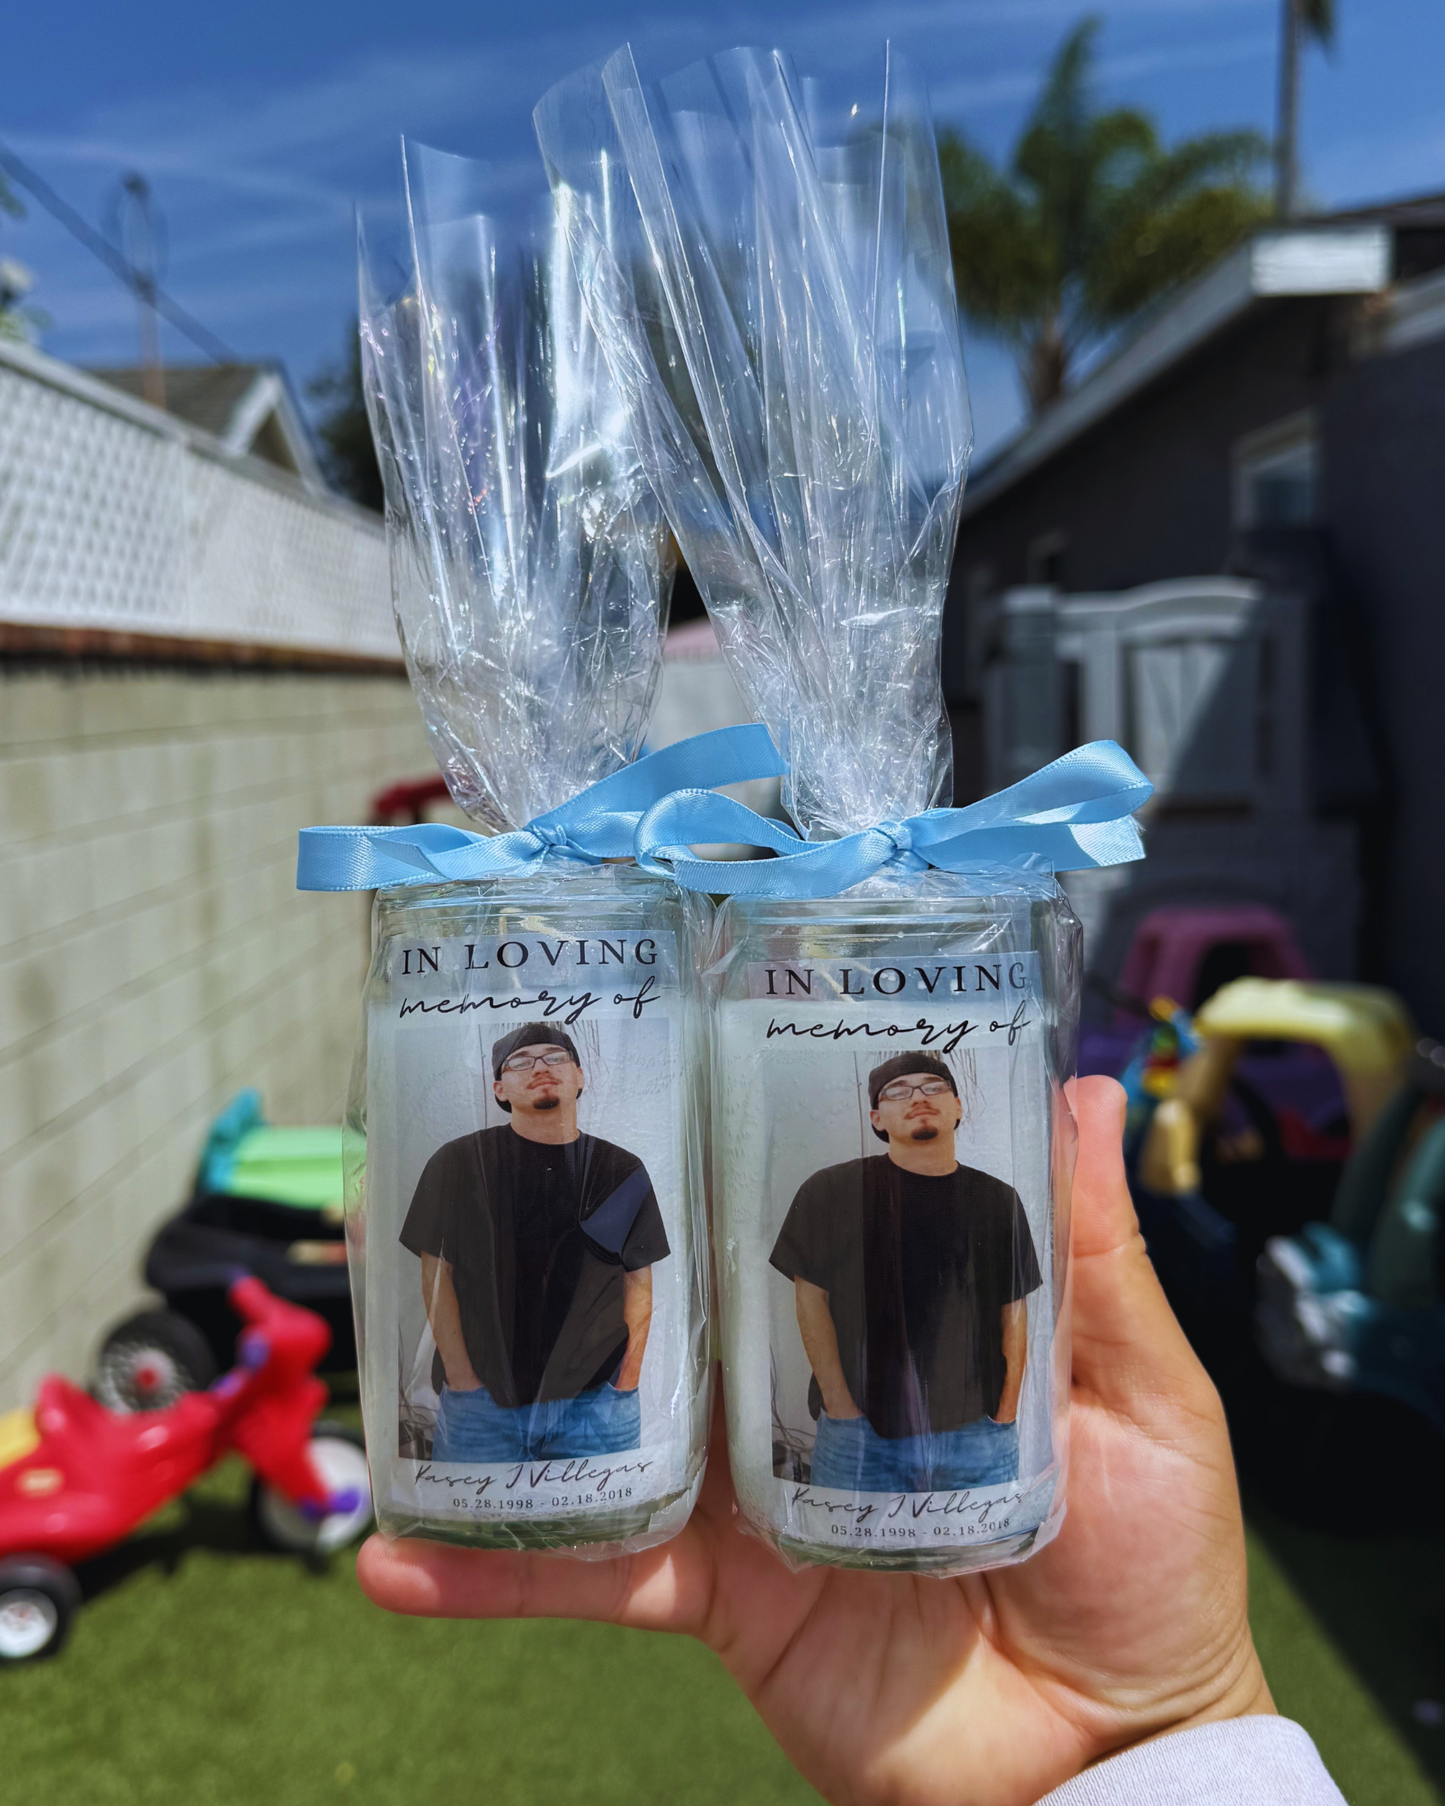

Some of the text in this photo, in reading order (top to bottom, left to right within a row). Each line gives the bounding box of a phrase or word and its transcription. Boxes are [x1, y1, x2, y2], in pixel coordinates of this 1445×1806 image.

[401, 938, 658, 975] IN LOVING
[764, 961, 1027, 996] IN LOVING
[399, 975, 661, 1025] memory of
[766, 999, 1032, 1054] memory of
[529, 1458, 654, 1492] Villegas
[452, 1497, 534, 1510] 05.28.1998
[551, 1486, 633, 1508] 02.18.2018
[830, 1523, 917, 1538] 05.28.1998
[932, 1517, 1011, 1537] 02.18.2018
